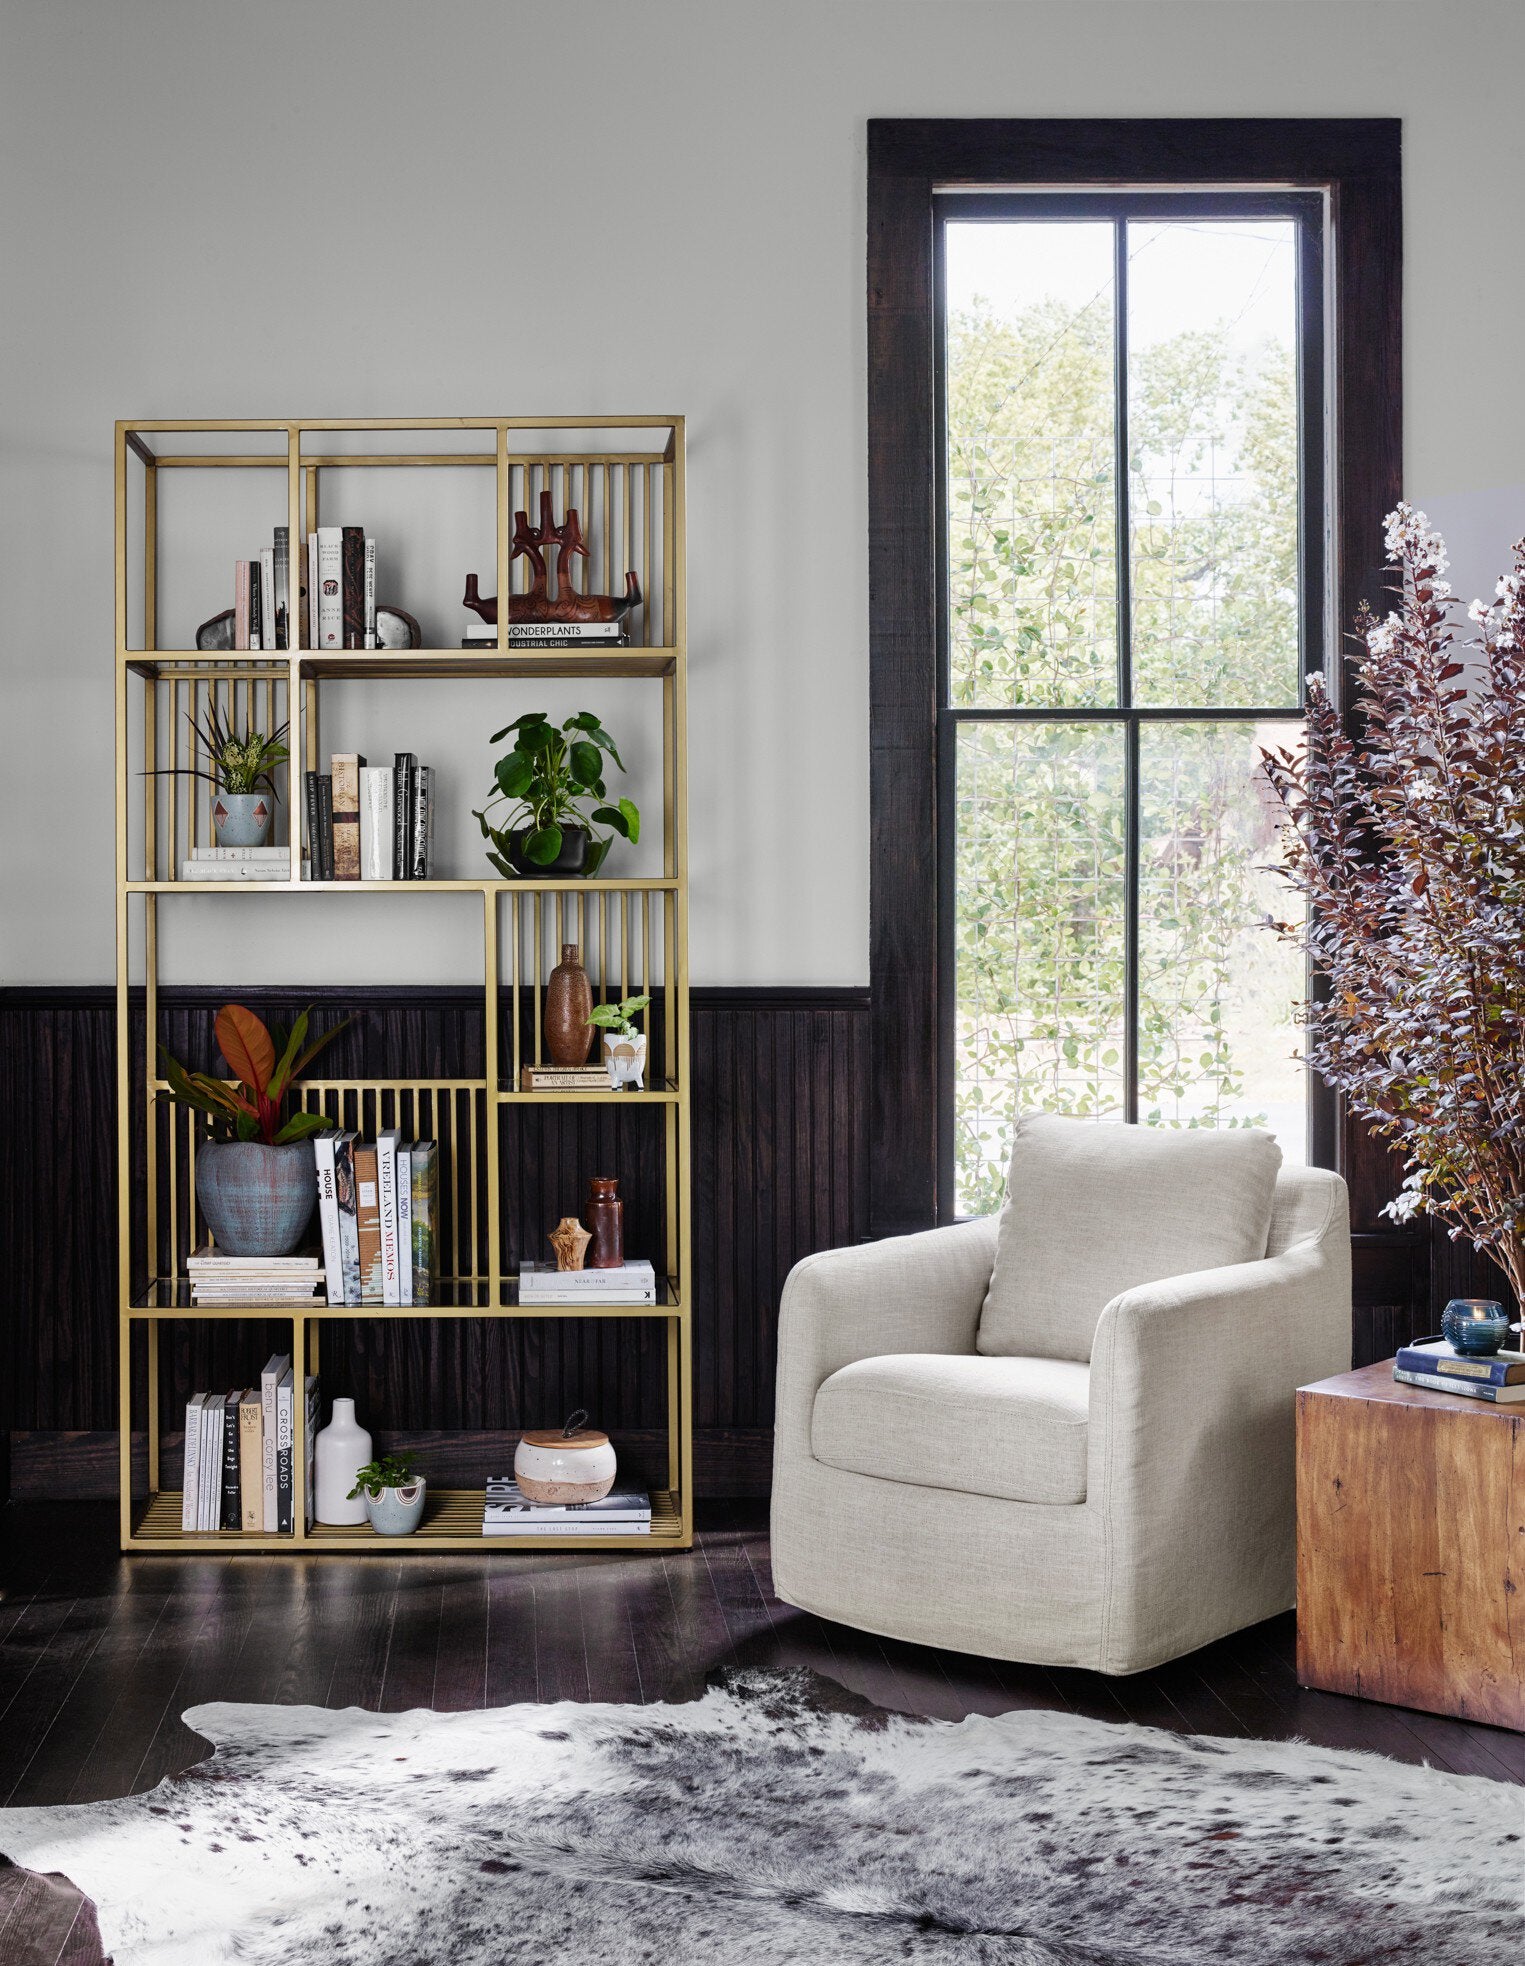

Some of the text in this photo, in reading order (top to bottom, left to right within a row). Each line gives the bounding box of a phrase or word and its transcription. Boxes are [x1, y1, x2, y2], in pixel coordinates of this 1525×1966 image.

[550, 639, 569, 647] CHIC
[399, 1159, 408, 1196] HOUSES
[323, 1169, 337, 1263] HOUSE DIANE KEATON
[381, 1151, 395, 1281] VREELAND MEMOS
[400, 1197, 409, 1220] NOW
[188, 1409, 197, 1437] BARBARA
[263, 1383, 276, 1491] benu corey lee
[187, 1437, 196, 1468] DELINSKY
[279, 1408, 289, 1490] CROSSROADS
